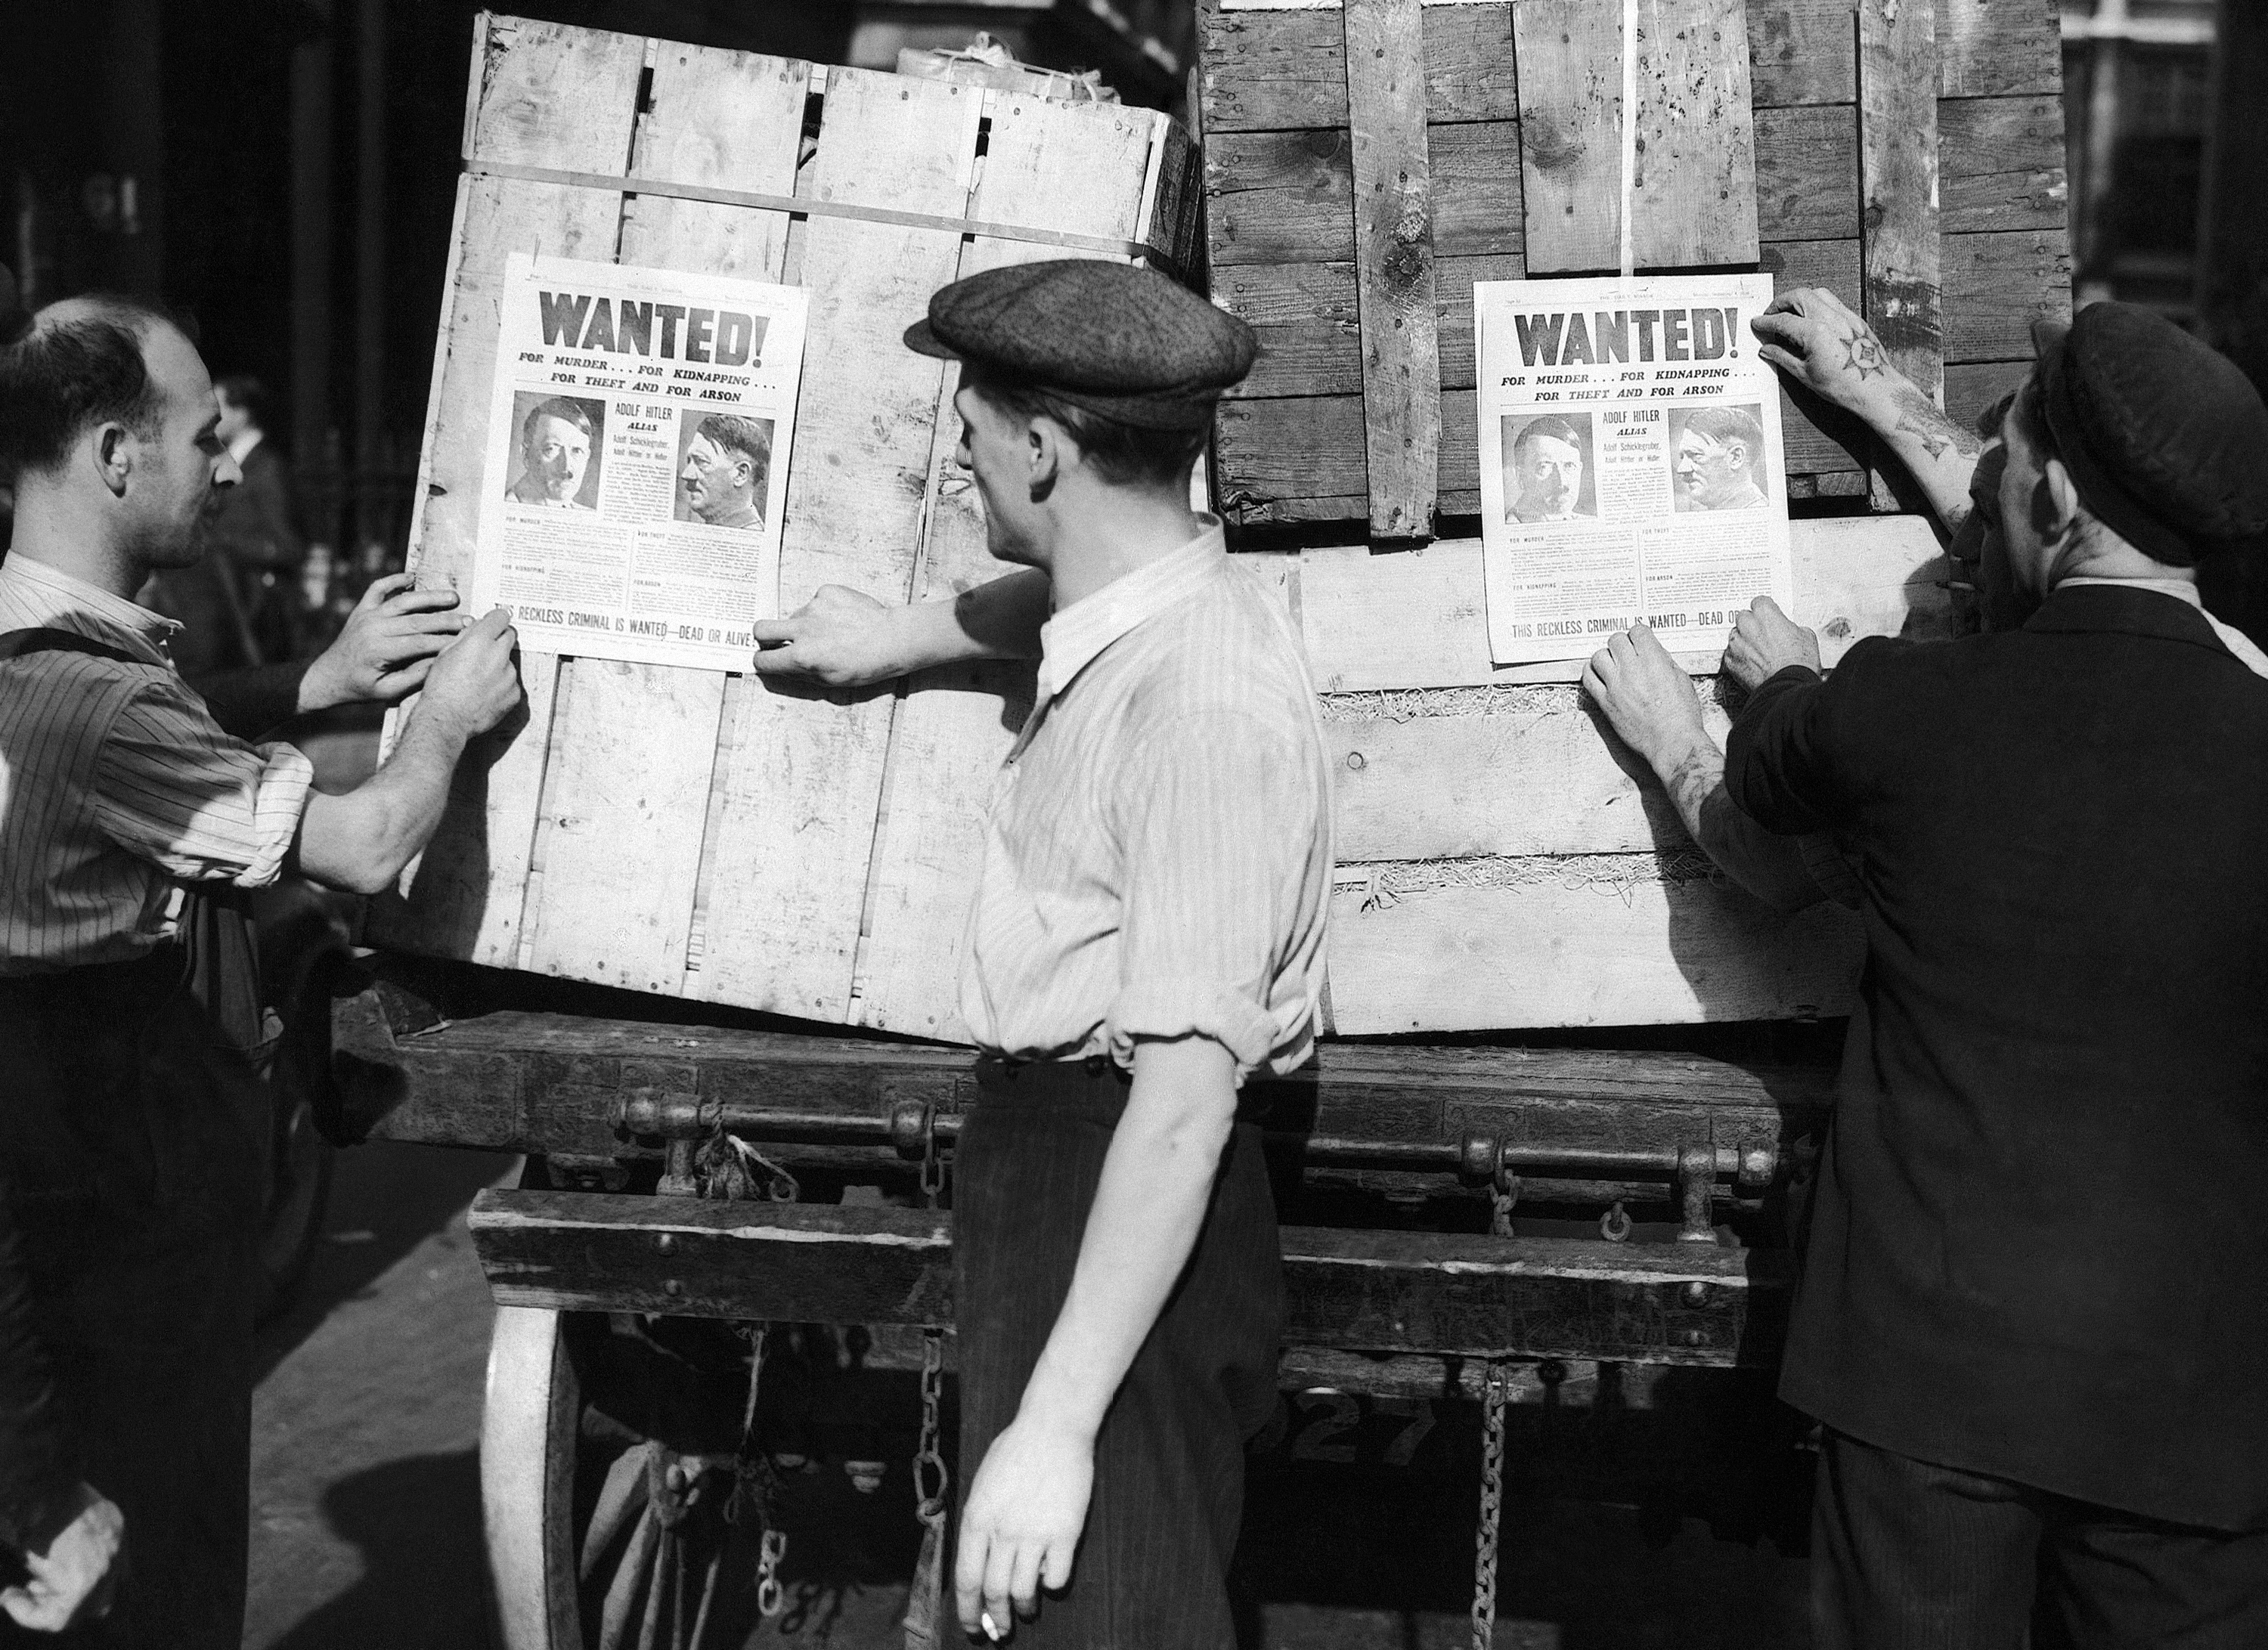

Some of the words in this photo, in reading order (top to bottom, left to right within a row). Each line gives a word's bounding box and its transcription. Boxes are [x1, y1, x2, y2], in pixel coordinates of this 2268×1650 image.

[539, 291, 770, 368] WANTED!
[1514, 308, 1738, 367] WANTED!
[519, 352, 544, 363] FOR
[638, 365, 663, 377] FOR
[550, 372, 576, 384] FOR
[585, 376, 626, 389] THEFT
[632, 381, 658, 393] AND
[666, 385, 692, 397] FOR
[699, 389, 742, 402] ARSON
[1501, 377, 1526, 386] FOR
[1620, 371, 1645, 382] FOR
[1535, 392, 1560, 401] FOR
[1569, 389, 1610, 401] THEFT
[1616, 388, 1643, 398] AND
[1650, 386, 1675, 397] FOR
[1682, 385, 1724, 395] ARSON
[615, 403, 641, 416] ADOLF
[646, 405, 673, 419] HITLER
[1603, 411, 1628, 424] ADOLF
[1633, 410, 1659, 422] HITLER
[627, 423, 658, 432] ALIAS
[1616, 427, 1647, 436] ALIAS
[519, 606, 564, 625] RECKLESS
[568, 611, 611, 630] CRIMINAL
[615, 618, 625, 632] IS
[708, 628, 720, 644] OR
[1512, 624, 1532, 639] THIS
[1537, 621, 1582, 636] RECKLESS
[1588, 617, 1630, 633] CRIMINAL
